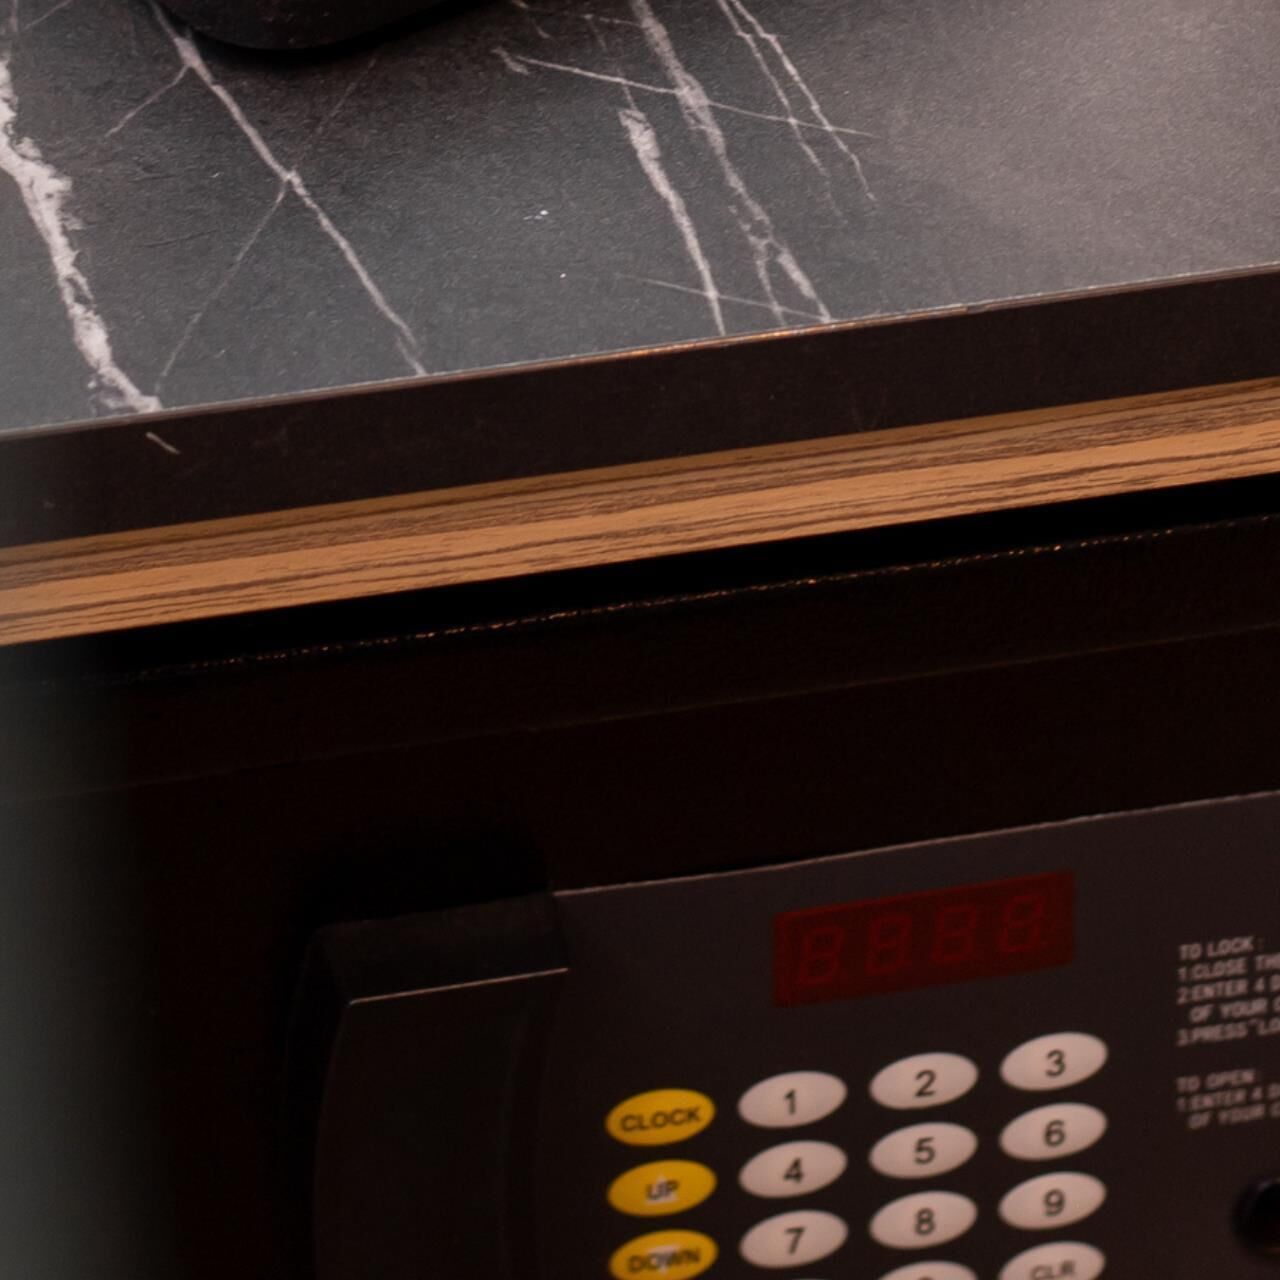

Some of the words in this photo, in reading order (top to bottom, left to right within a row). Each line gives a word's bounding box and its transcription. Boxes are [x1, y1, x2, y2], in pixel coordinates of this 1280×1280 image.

[1179, 943, 1202, 960] TO
[1254, 977, 1265, 992] 4
[1190, 1004, 1213, 1023] OF
[1222, 997, 1268, 1018] YOUR
[1046, 1050, 1066, 1077] 3
[915, 1070, 936, 1098] 2
[1177, 1075, 1200, 1092] TO
[784, 1089, 796, 1115] 1
[622, 1108, 700, 1132] CLOCK
[1188, 1111, 1211, 1129] OF
[1044, 1120, 1065, 1147] 6
[914, 1138, 936, 1164] 5
[783, 1158, 804, 1183] 4
[645, 1179, 679, 1200] UP
[1044, 1189, 1065, 1216] 9
[914, 1208, 935, 1236] 8
[785, 1227, 806, 1255] 7
[628, 1248, 700, 1273] DOWN
